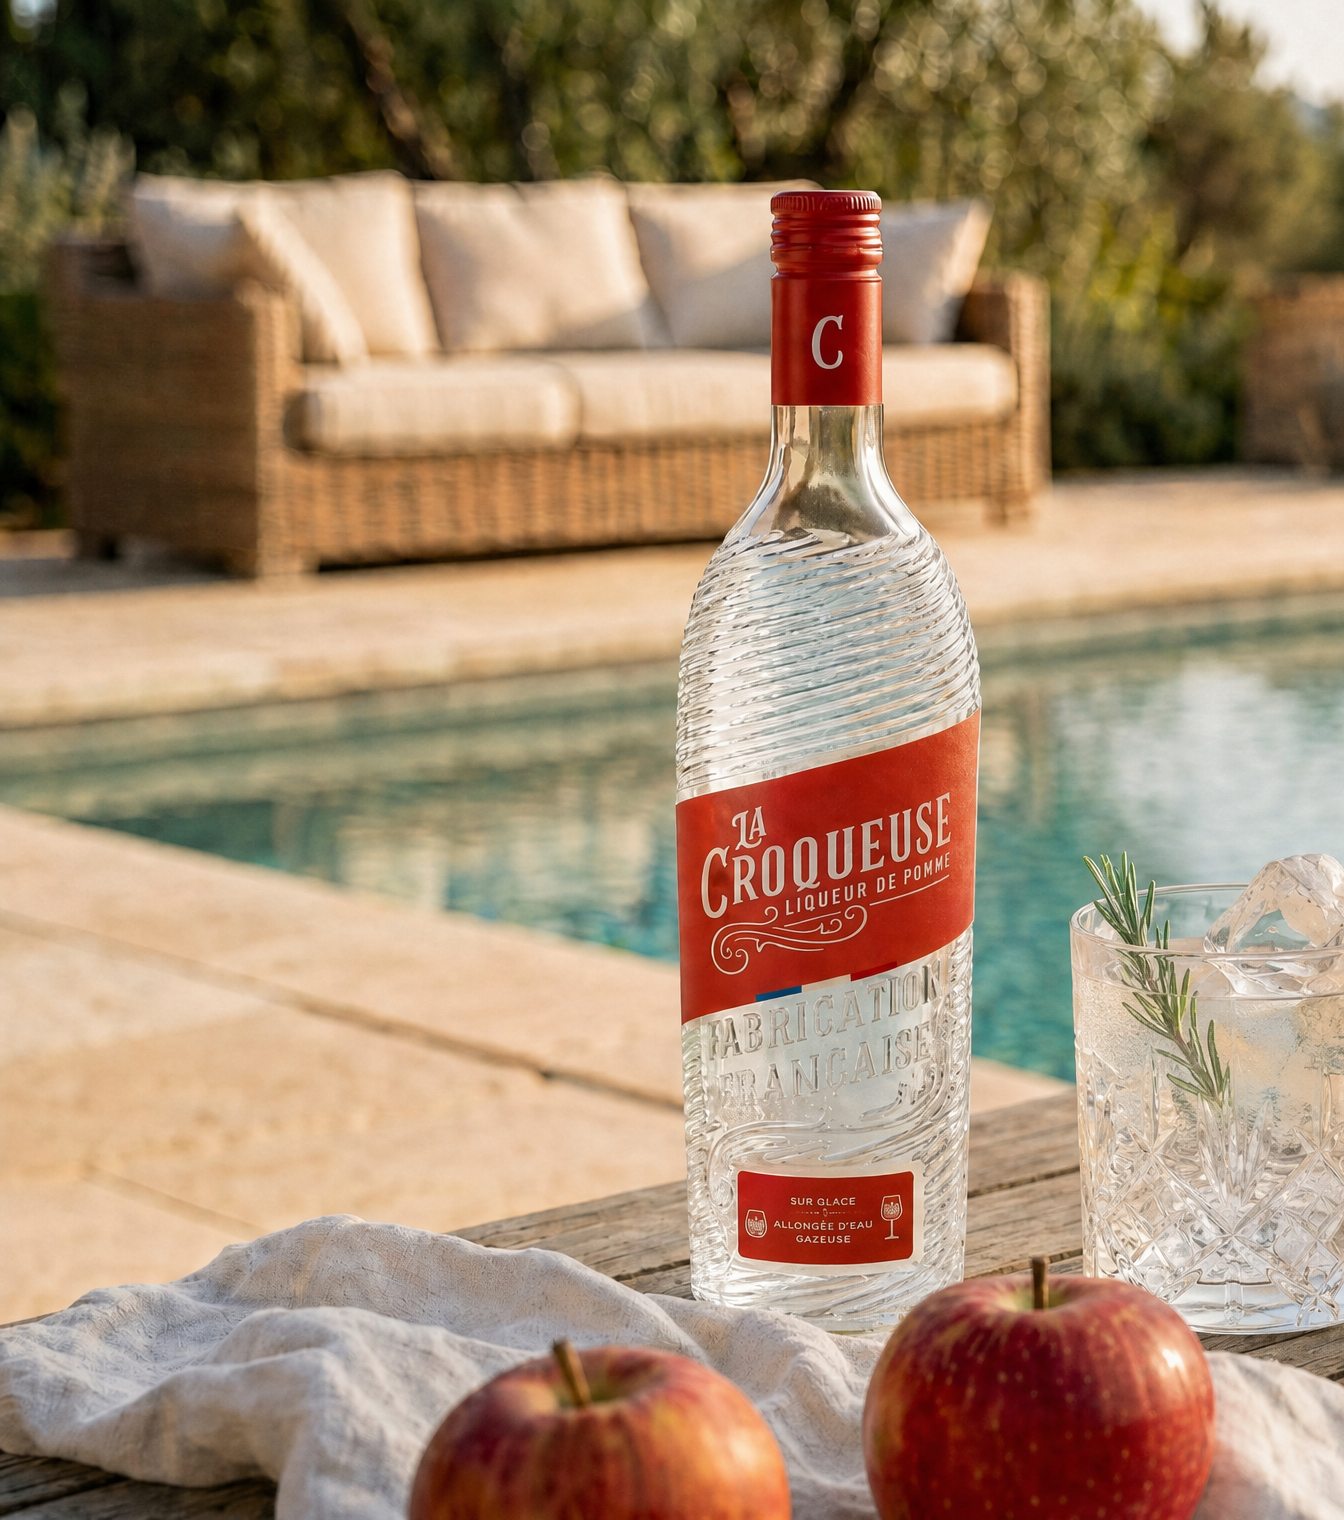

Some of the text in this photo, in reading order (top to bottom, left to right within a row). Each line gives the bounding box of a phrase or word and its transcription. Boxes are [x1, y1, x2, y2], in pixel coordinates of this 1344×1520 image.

[811, 314, 844, 370] C
[731, 806, 767, 850] LA
[701, 792, 952, 919] CROQUEUSE
[785, 852, 950, 916] LIQUEUR DE POMME
[708, 963, 942, 1061] FABRICATION
[773, 1220, 873, 1231] ALLONGÉE D'EAU
[790, 1197, 856, 1206] SUR GLACE
[795, 1235, 851, 1244] GAZEUSE
